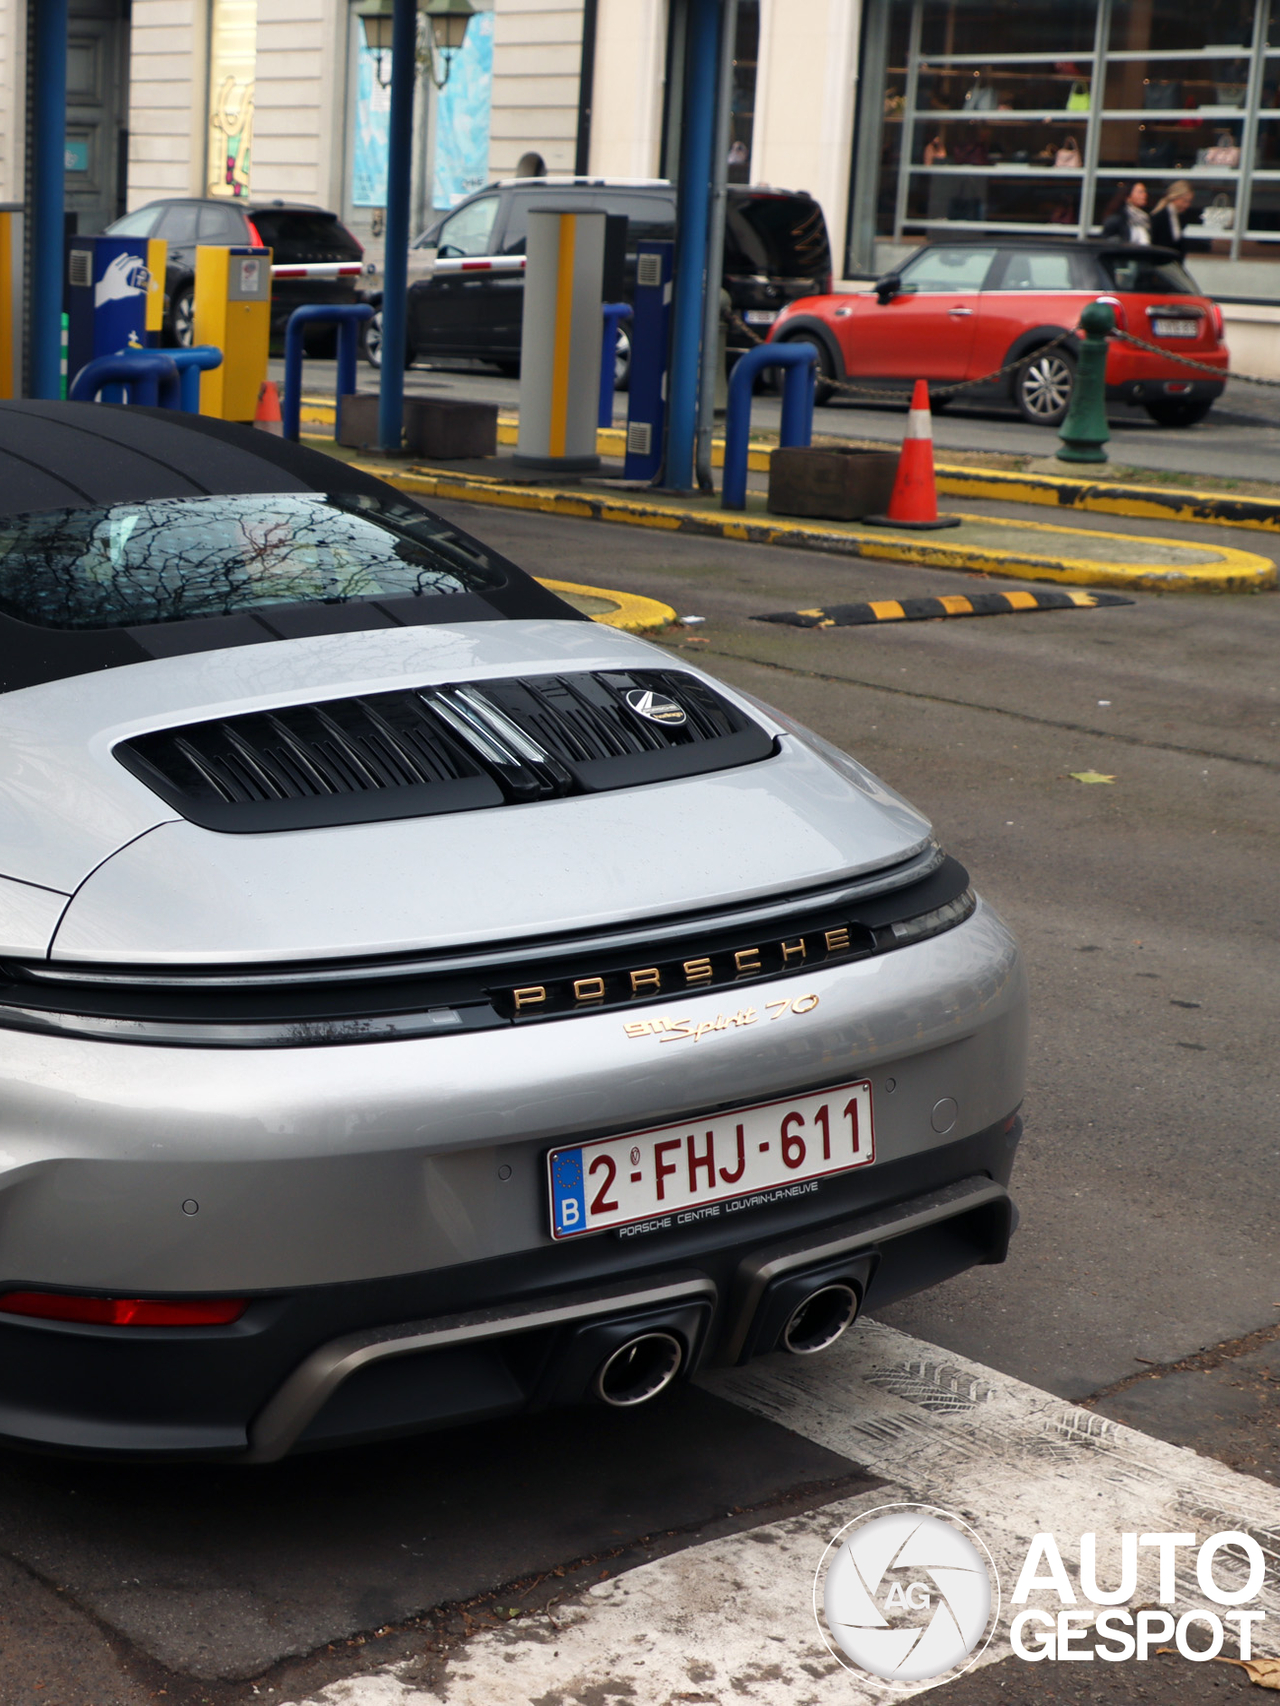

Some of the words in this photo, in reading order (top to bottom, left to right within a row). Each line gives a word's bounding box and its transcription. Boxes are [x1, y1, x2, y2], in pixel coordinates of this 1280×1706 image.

[513, 927, 851, 1010] PORSCHE
[622, 1015, 674, 1039] 911
[659, 1007, 760, 1042] Spirit
[765, 993, 820, 1020] 70
[588, 1097, 860, 1216] 2-FHJ-611
[561, 1197, 580, 1227] B
[619, 1217, 672, 1239] PORSCHE
[677, 1205, 721, 1225] CENTRE
[725, 1181, 819, 1214] LOUVAIN-LA-NEUVE
